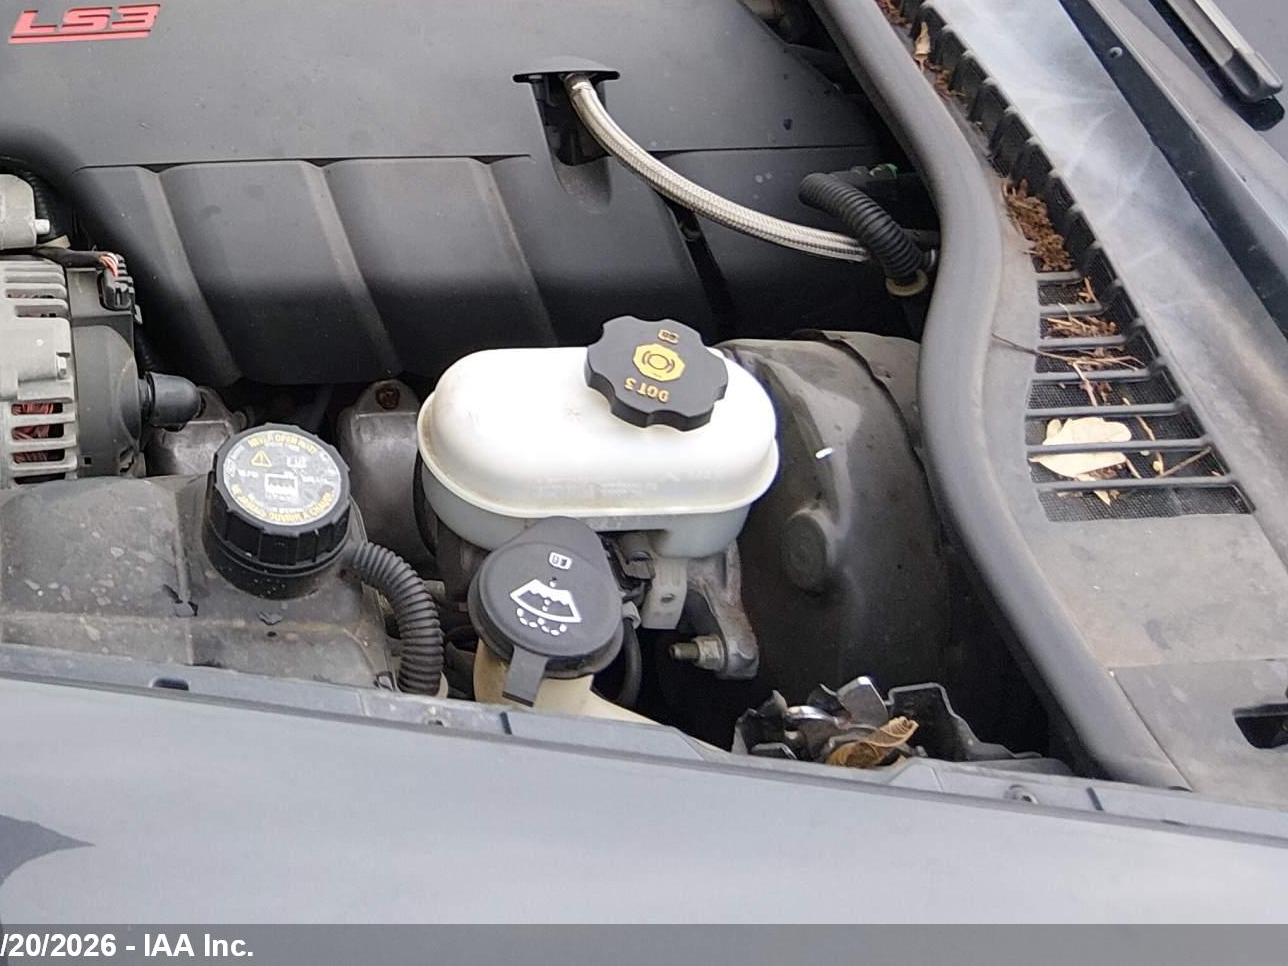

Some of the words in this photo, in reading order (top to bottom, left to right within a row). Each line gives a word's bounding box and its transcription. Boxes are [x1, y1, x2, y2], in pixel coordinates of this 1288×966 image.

[12, 3, 161, 43] LS3
[624, 377, 637, 391] 3
[637, 382, 669, 403] DOT
